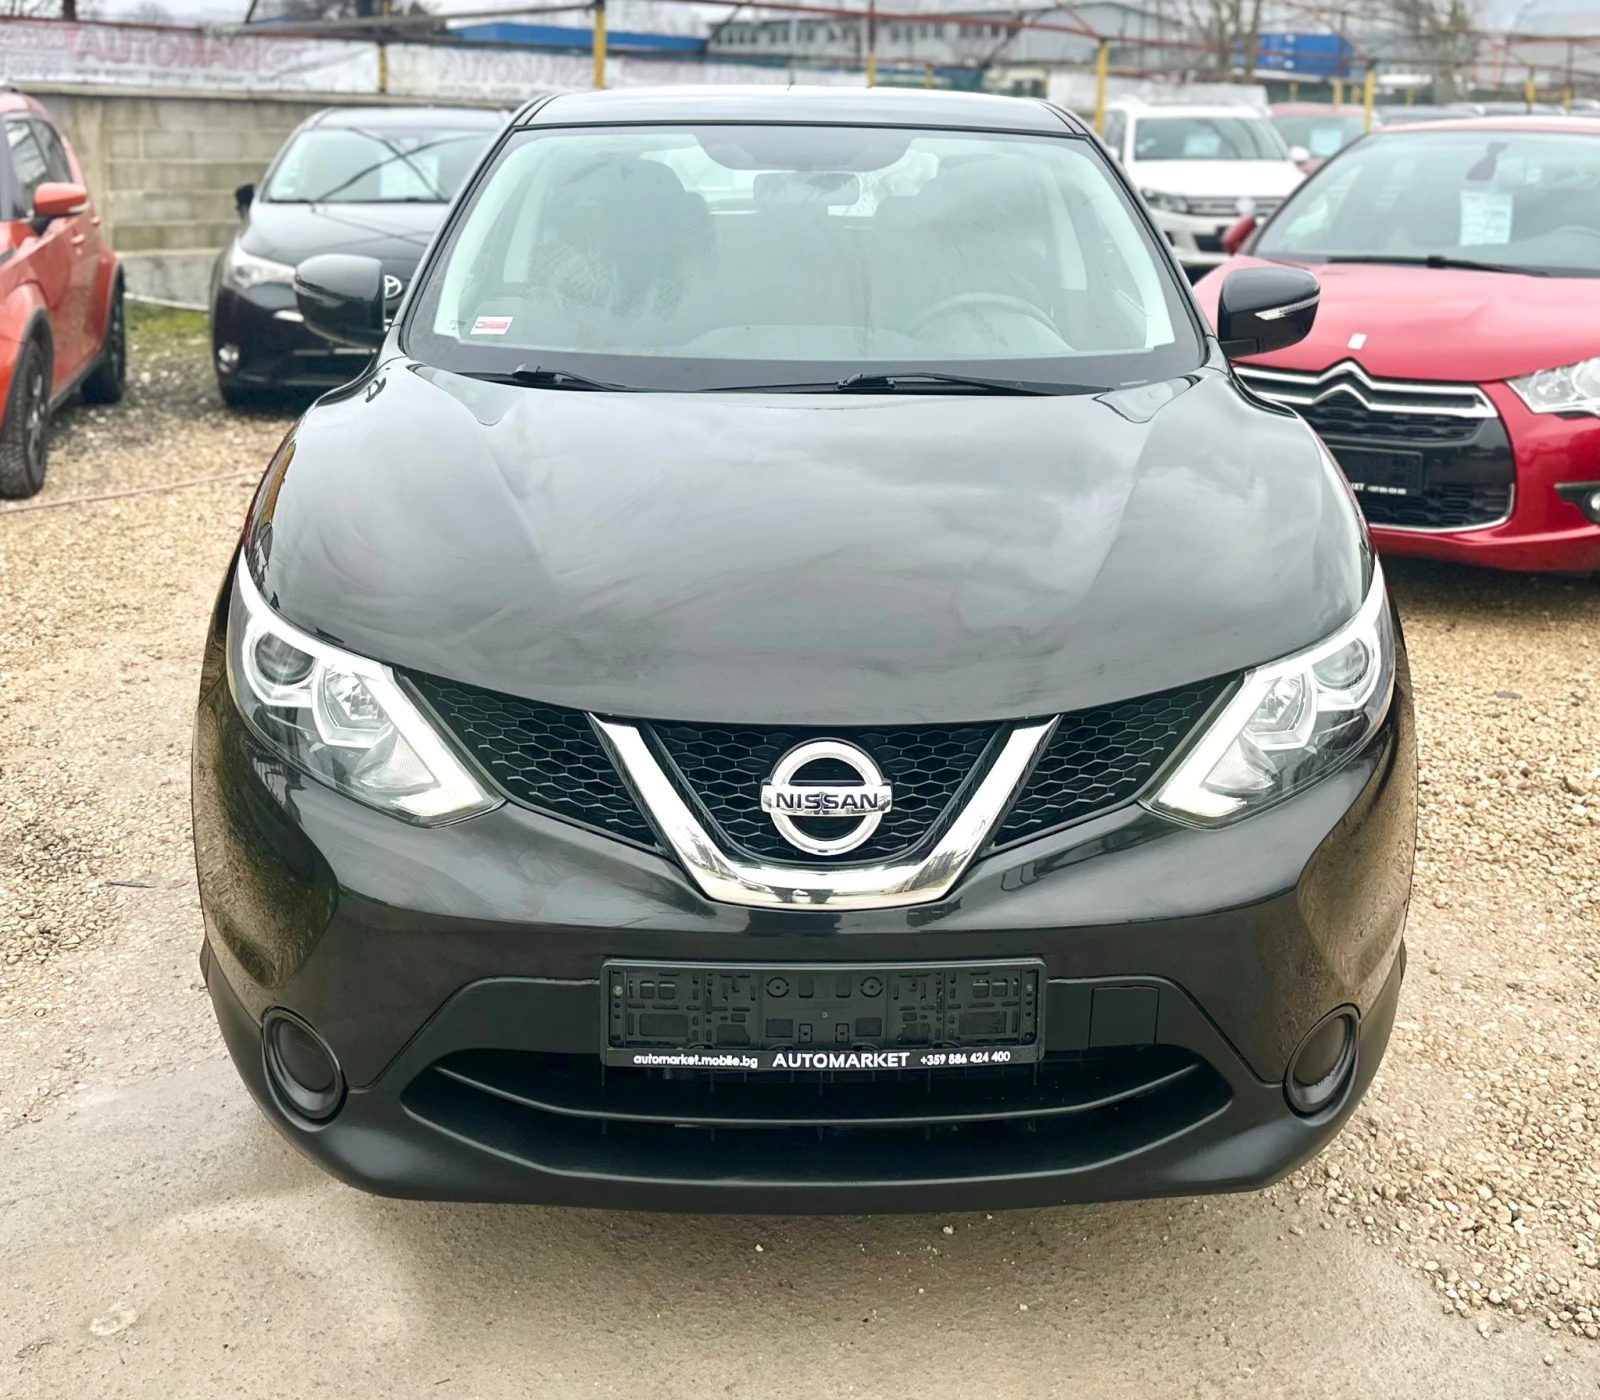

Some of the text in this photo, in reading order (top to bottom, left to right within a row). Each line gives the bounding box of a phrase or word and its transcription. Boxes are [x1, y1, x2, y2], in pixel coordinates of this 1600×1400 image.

[776, 792, 878, 810] NISSAN
[633, 1050, 1011, 1069] automarket.mobile.bg AUTOMARKET +359 886 424 400
